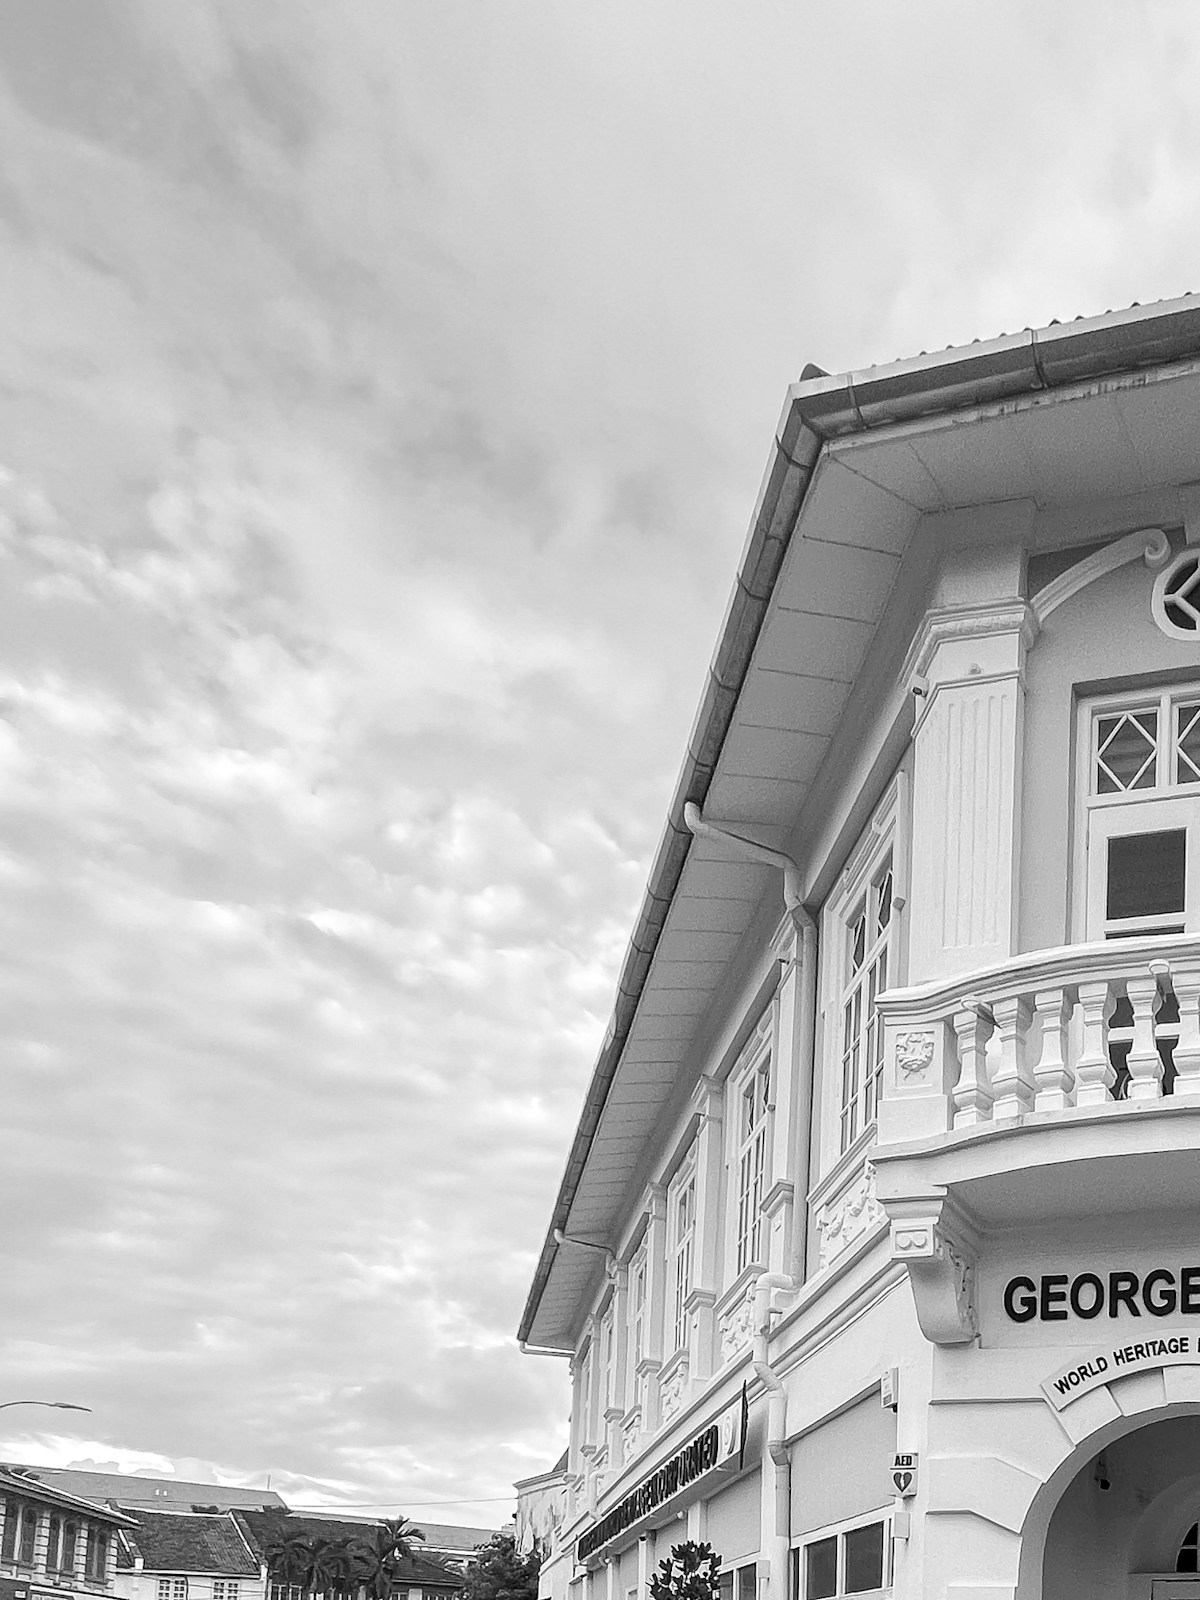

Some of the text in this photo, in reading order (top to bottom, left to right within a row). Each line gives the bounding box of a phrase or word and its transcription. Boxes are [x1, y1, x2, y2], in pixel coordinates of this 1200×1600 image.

[1053, 1356, 1109, 1395] WORLD
[1113, 1337, 1190, 1367] HERITAGE
[894, 1455, 912, 1466] AED
